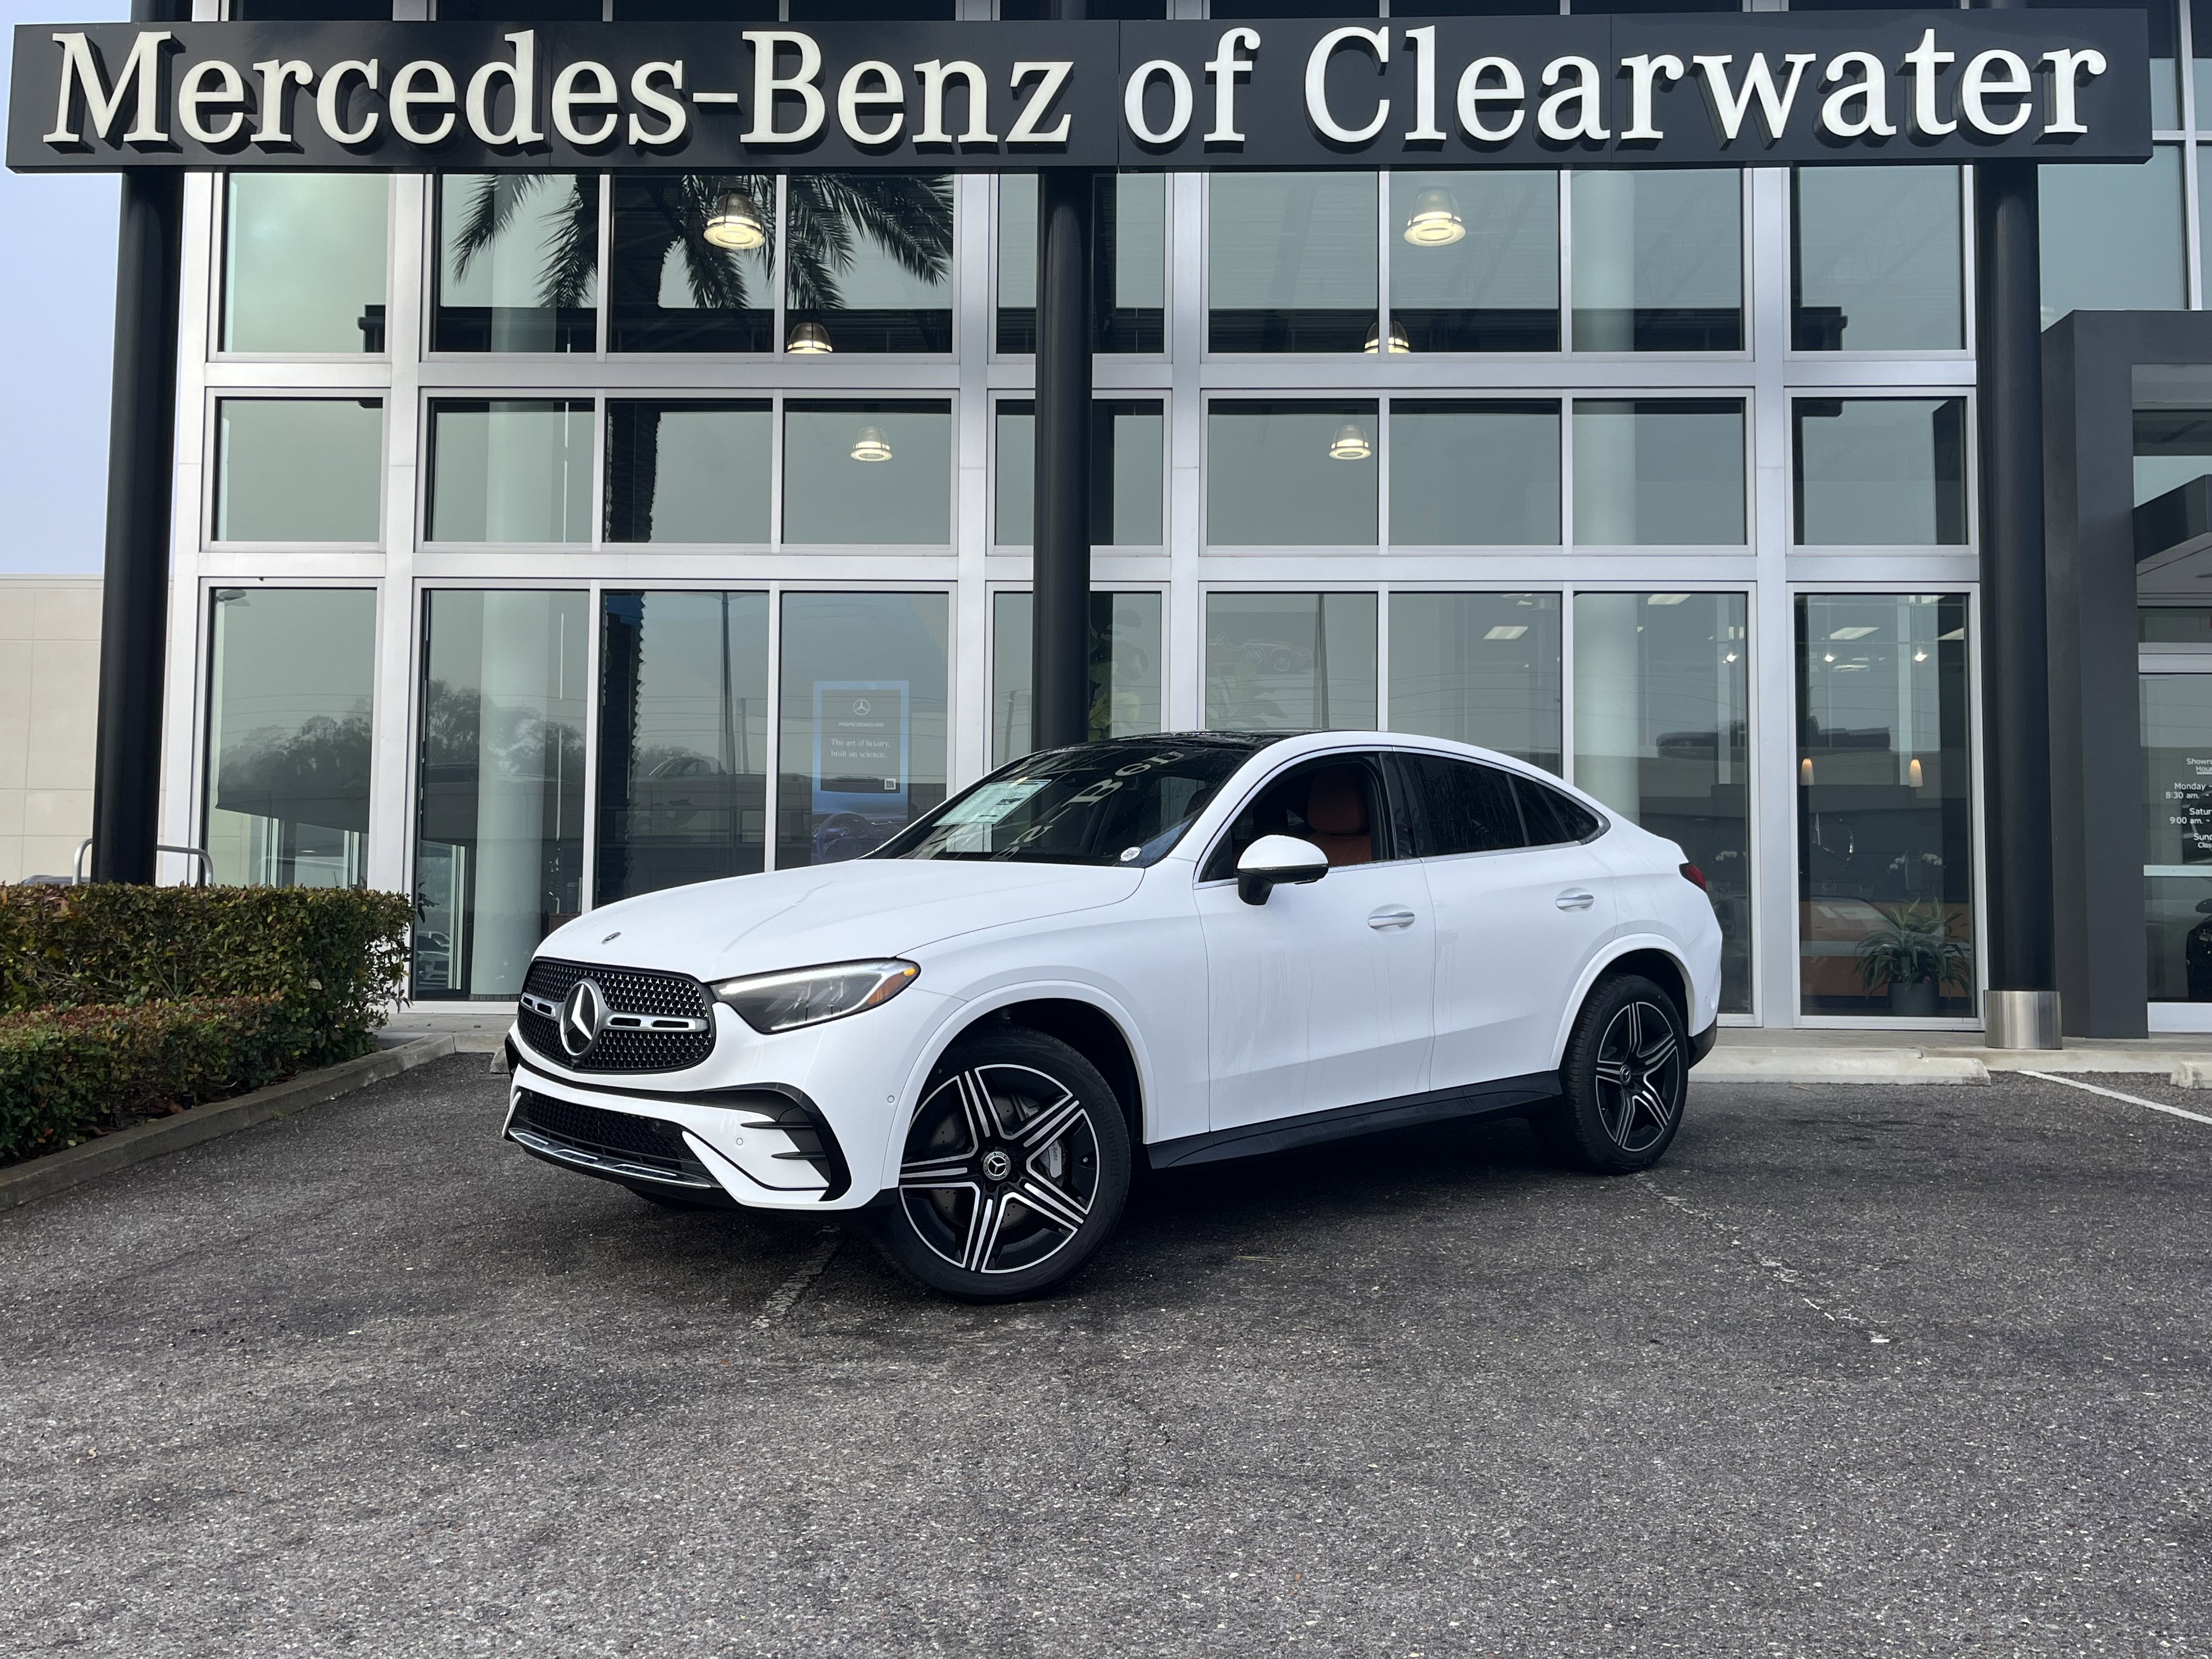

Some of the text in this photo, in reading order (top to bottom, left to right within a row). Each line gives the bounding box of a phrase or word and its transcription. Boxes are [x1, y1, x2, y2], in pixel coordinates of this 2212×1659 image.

[43, 25, 2107, 146] Mercedes-Benz of Clearwater
[831, 738, 844, 747] The
[866, 739, 890, 749] luxury,
[831, 749, 847, 758] built
[2174, 783, 2206, 791] Monday
[1094, 1099, 1121, 1176] Continental
